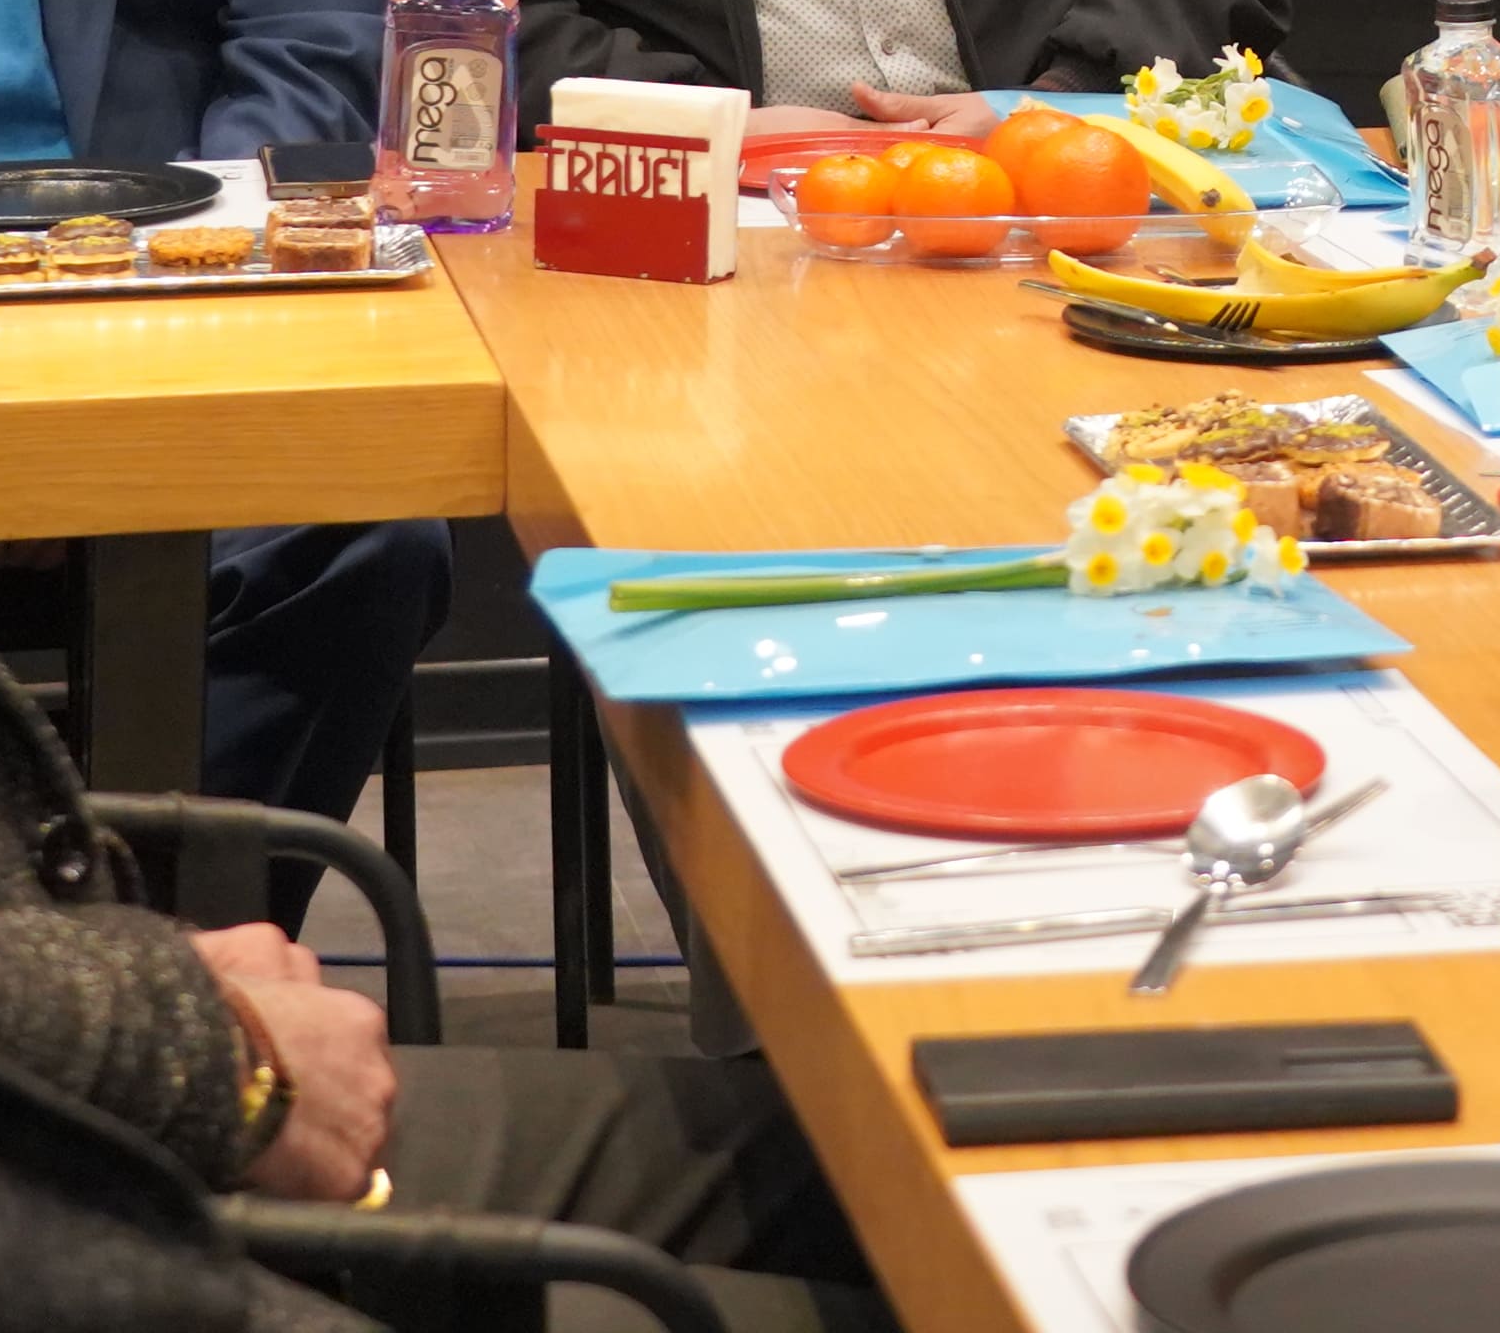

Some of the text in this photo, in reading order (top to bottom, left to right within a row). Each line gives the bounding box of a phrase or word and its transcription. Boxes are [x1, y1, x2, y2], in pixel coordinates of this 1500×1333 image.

[411, 55, 459, 163] mega
[534, 144, 709, 201] TRAVEL
[1425, 118, 1450, 232] mega
